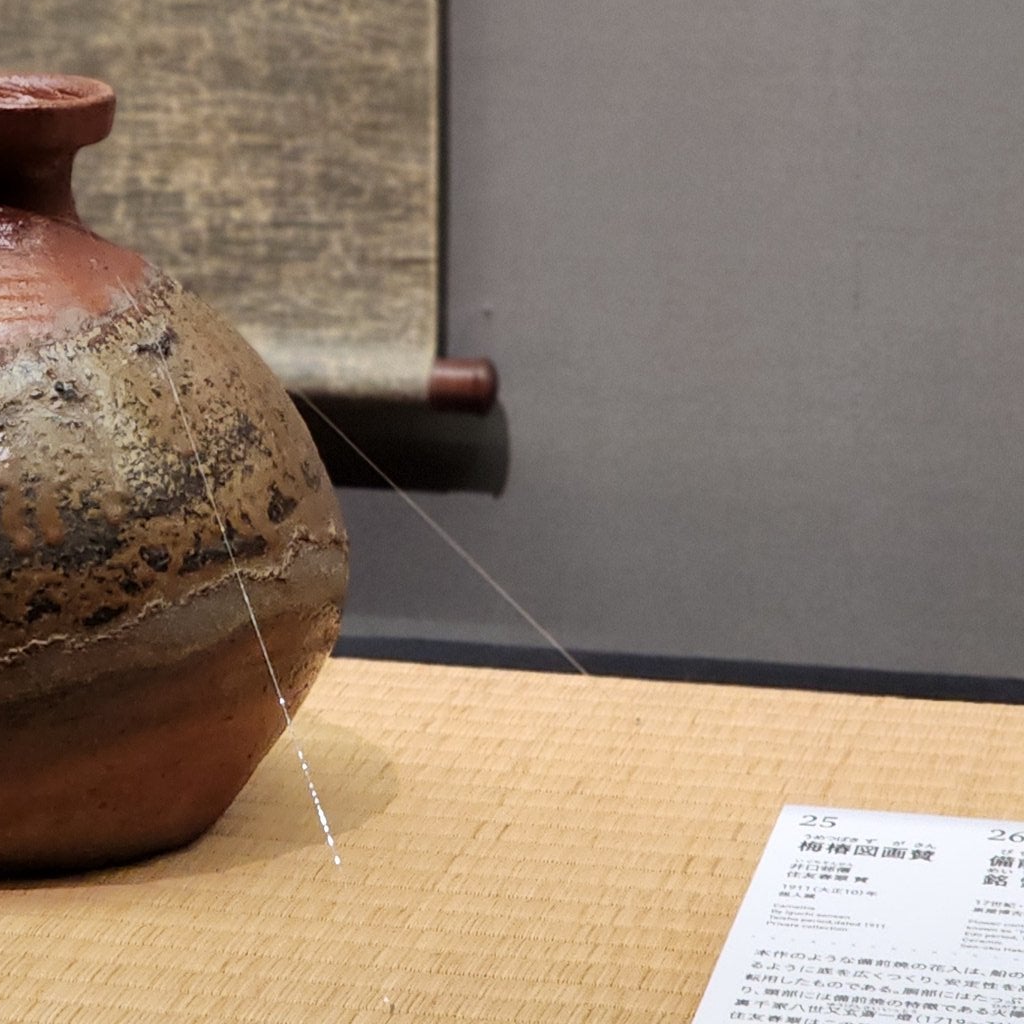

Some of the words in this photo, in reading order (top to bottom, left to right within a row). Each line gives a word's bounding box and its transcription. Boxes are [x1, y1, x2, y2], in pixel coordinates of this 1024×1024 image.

[799, 815, 838, 828] 25
[987, 829, 1024, 843] 26
[798, 840, 935, 862] 梅椿図画賛
[989, 855, 1024, 869] 備
